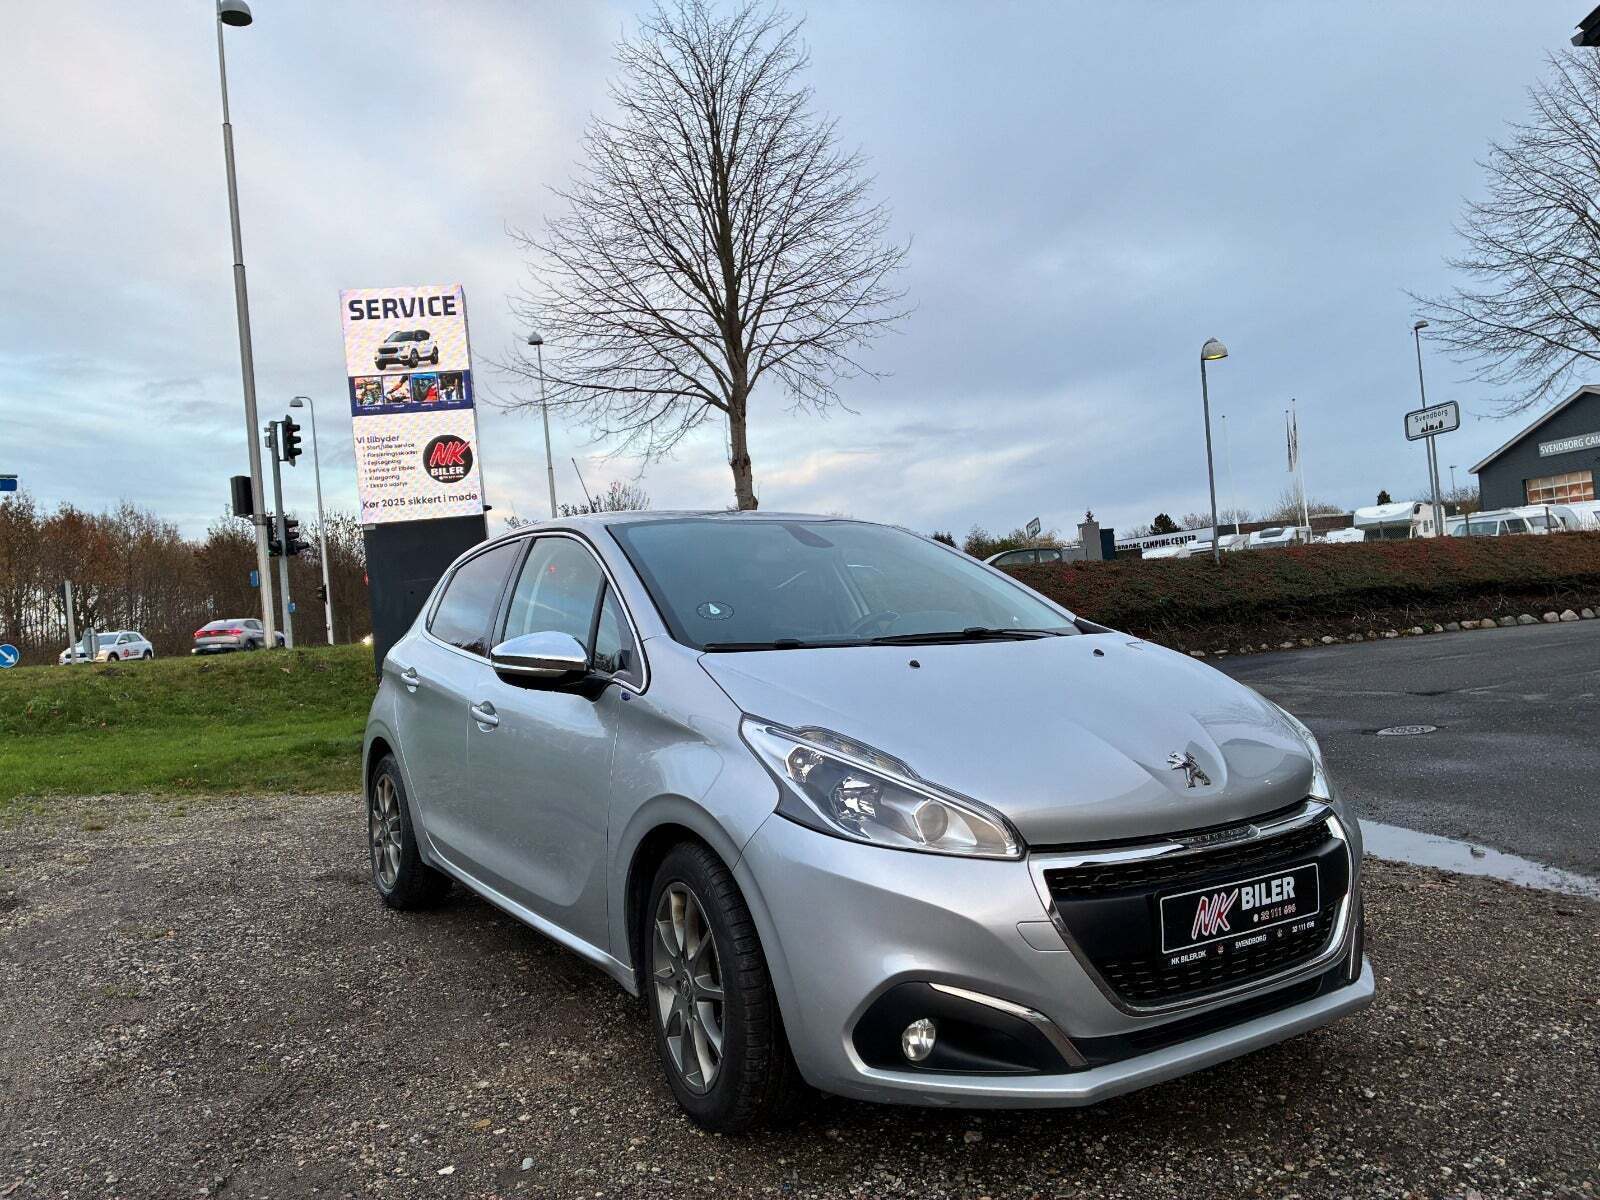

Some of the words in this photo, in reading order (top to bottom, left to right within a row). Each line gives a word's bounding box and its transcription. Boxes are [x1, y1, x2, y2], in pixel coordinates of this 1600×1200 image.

[348, 295, 456, 320] SERVICE
[1415, 410, 1448, 422] Svendborg
[356, 436, 365, 444] Vi
[367, 435, 399, 445] tilbyder
[1540, 438, 1584, 454] SVENDBORG
[430, 440, 470, 467] NK
[430, 467, 464, 476] BILER
[363, 500, 379, 510] Kør
[381, 498, 406, 507] 2025
[408, 495, 442, 505] sikkert
[443, 494, 446, 502] i
[448, 492, 477, 502] møde
[1142, 538, 1170, 549] CAMPING
[1171, 535, 1196, 545] CENTER
[1191, 888, 1239, 940] NK
[1241, 876, 1295, 911] BILER
[1171, 956, 1180, 965] NK
[1181, 950, 1207, 963] BILER.DK
[1235, 934, 1267, 949] SVENDBORG
